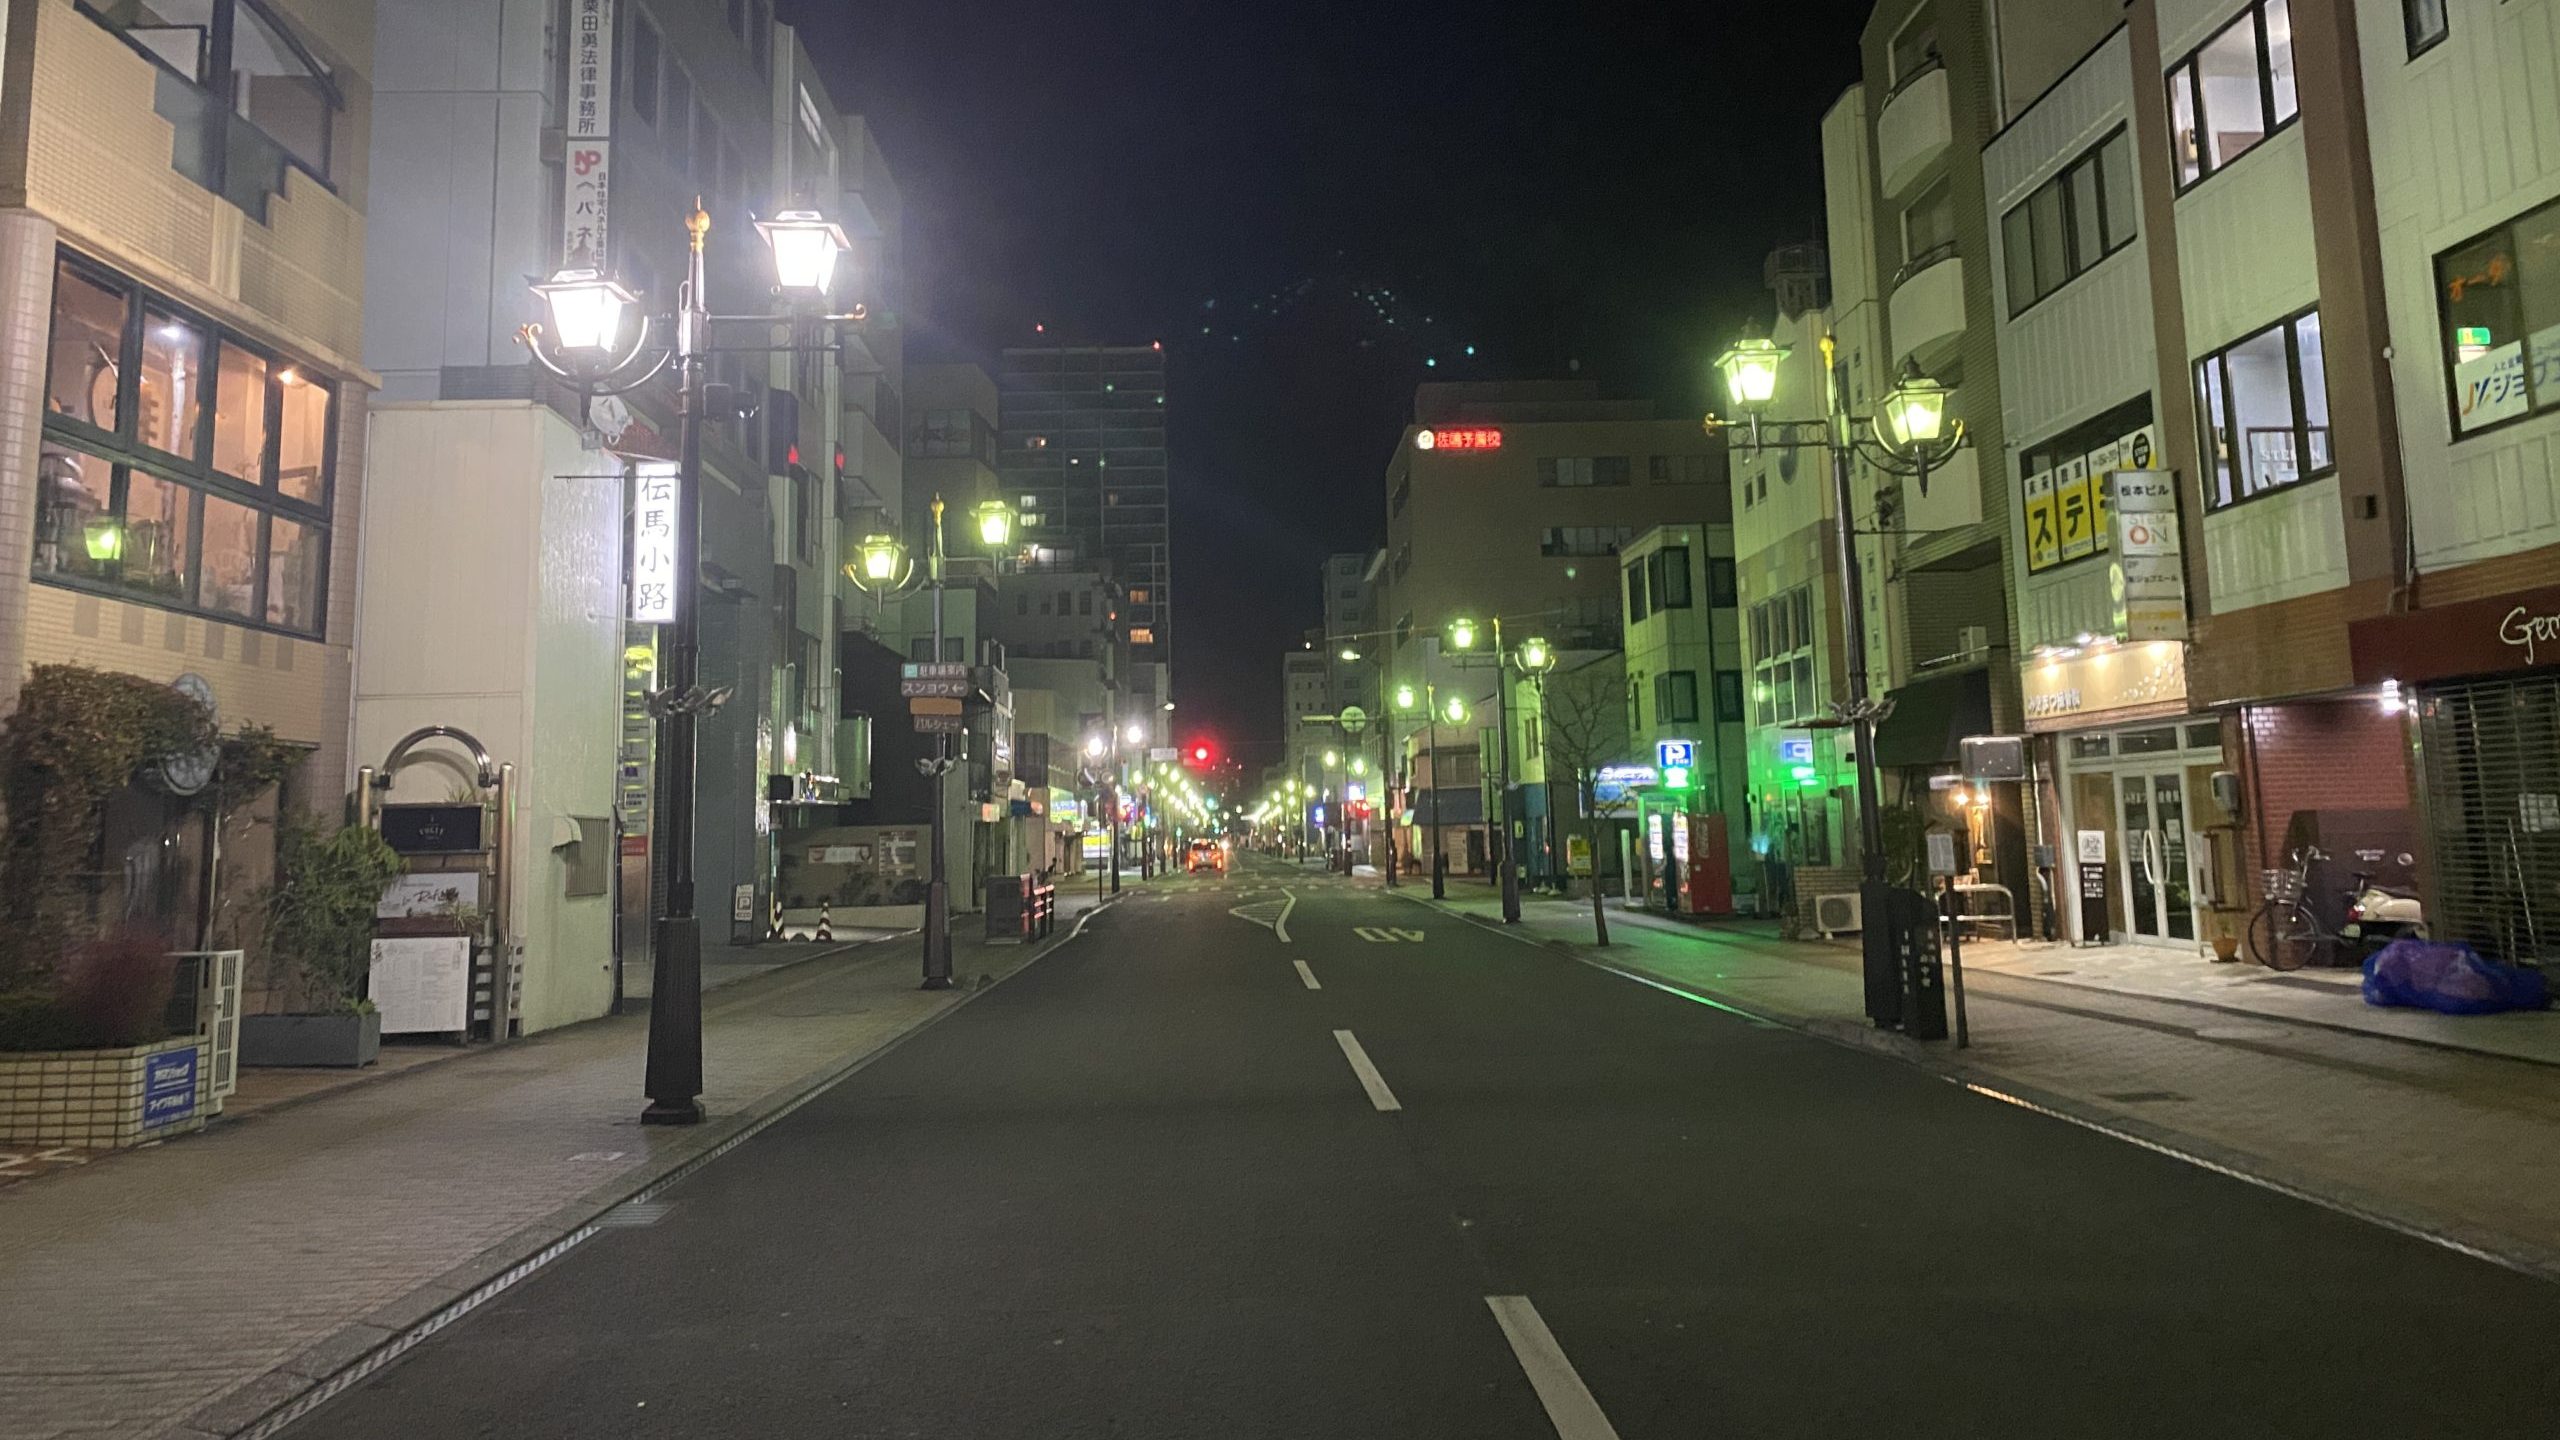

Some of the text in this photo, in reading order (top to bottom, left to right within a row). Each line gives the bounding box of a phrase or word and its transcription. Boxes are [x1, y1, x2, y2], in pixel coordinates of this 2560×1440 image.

[2121, 485, 2169, 496] 松本ビル
[638, 474, 671, 611] 伝馬小路
